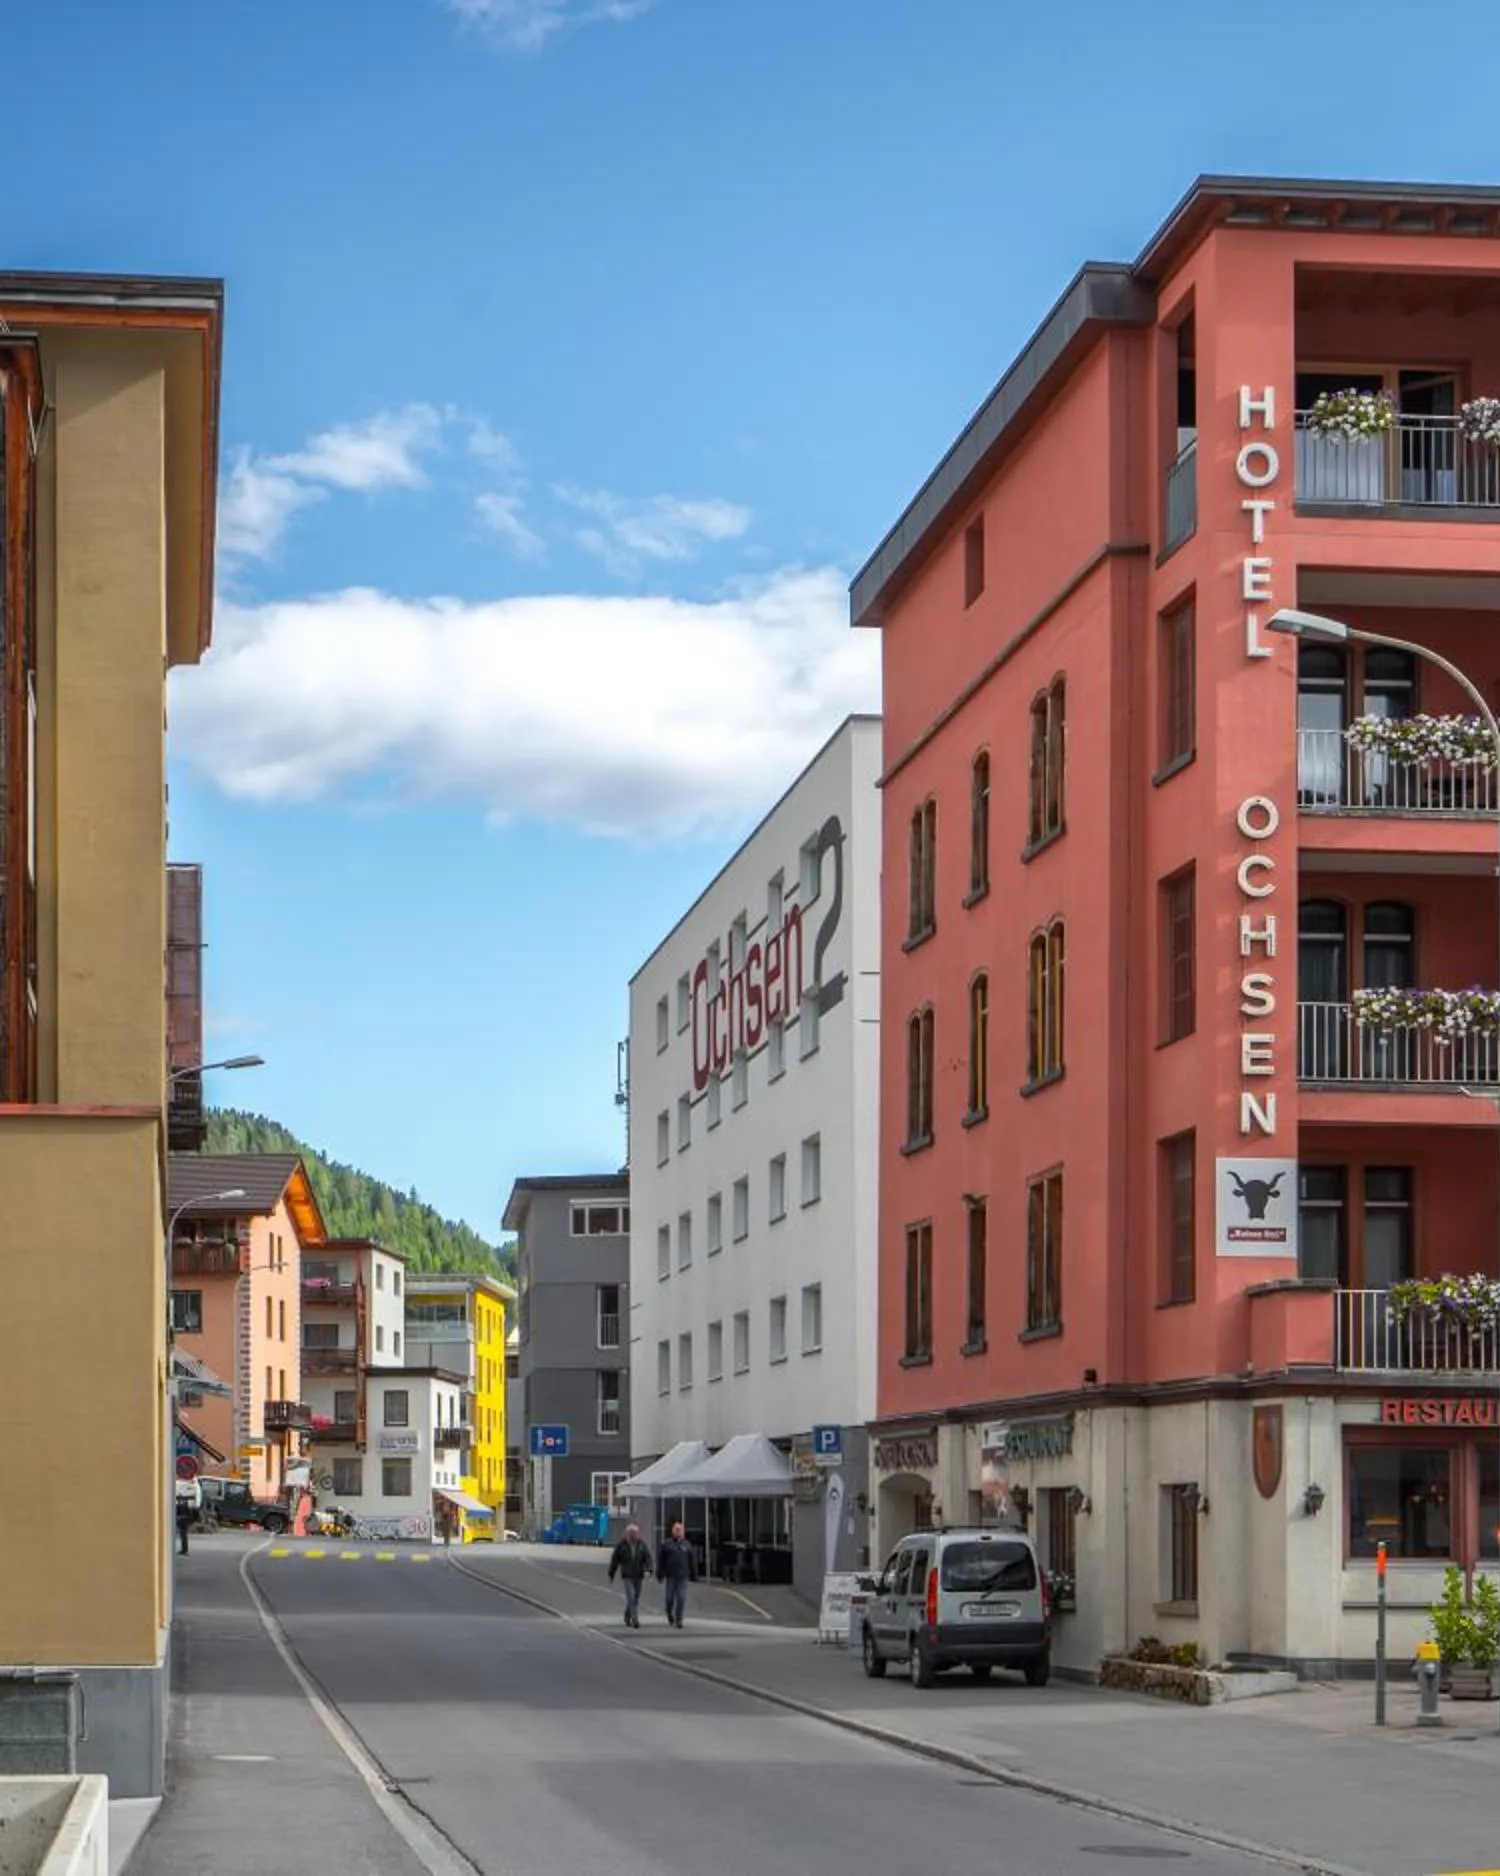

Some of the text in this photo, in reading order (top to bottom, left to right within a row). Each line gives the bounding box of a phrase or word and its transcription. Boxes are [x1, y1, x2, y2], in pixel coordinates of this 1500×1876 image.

[1236, 385, 1279, 1114] HOTEL OCHSEN
[692, 904, 803, 1090] Ochsen
[821, 1430, 836, 1452] P
